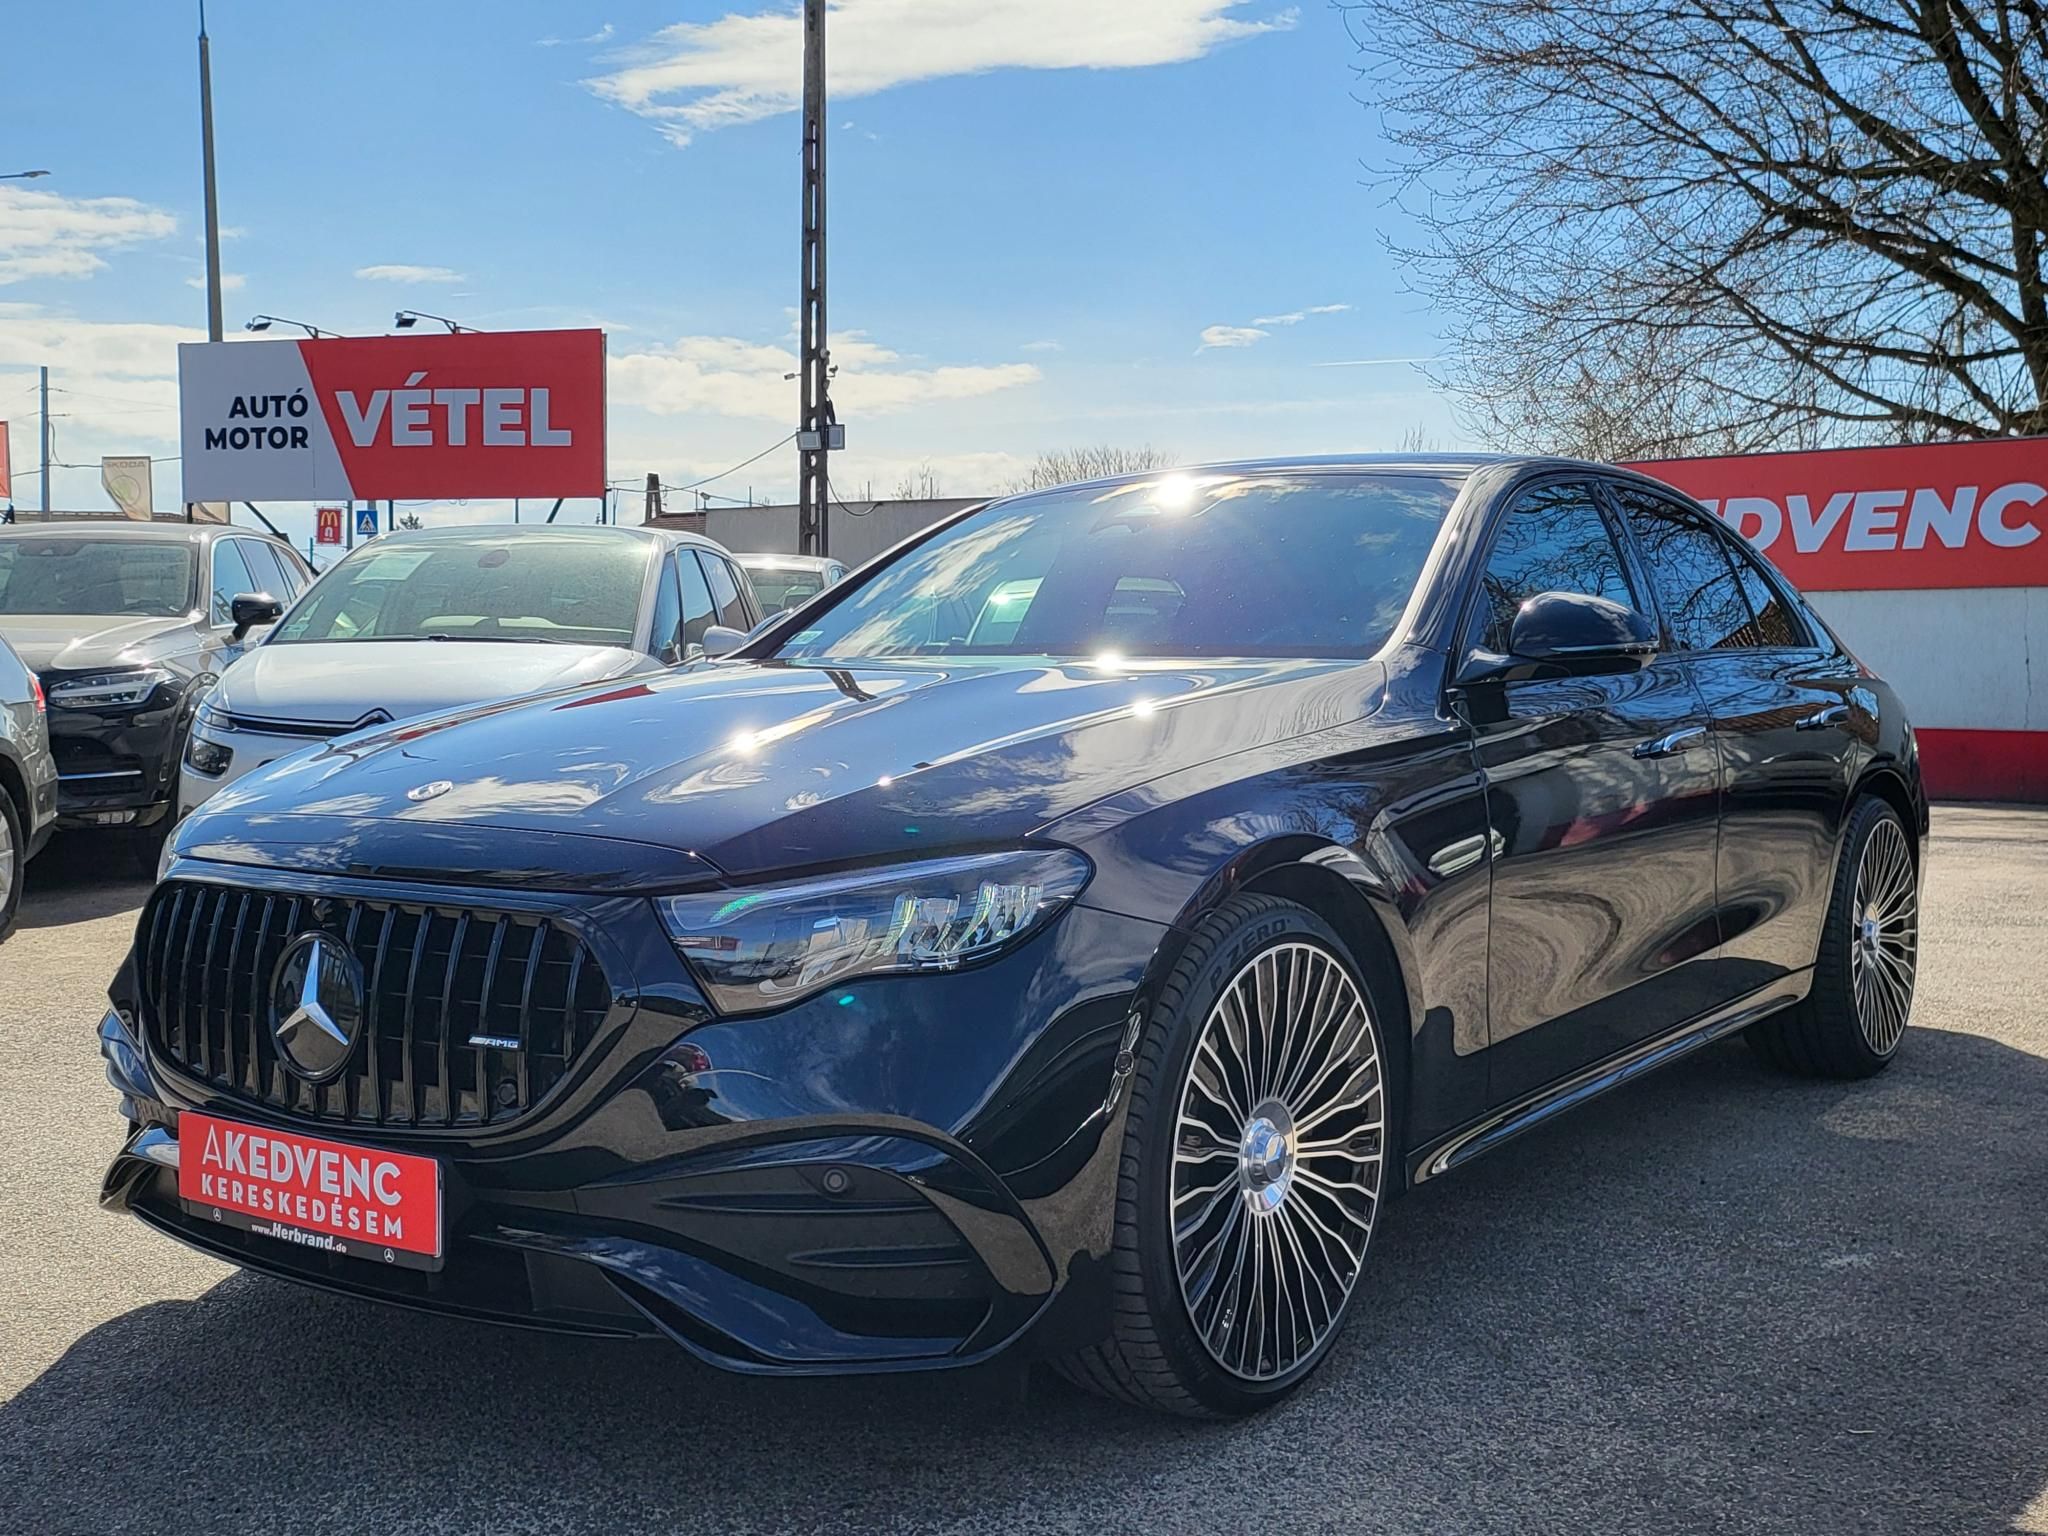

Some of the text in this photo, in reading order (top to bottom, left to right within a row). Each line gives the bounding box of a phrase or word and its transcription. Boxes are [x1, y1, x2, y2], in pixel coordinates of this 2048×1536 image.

[228, 387, 309, 419] AUTÓ
[335, 371, 573, 448] VÉTEL
[204, 425, 309, 450] MOTOR
[1700, 482, 2047, 554] DVENC
[484, 1038, 519, 1049] AMG
[201, 1172, 403, 1240] KERESKEDÉSEM
[251, 1222, 348, 1255] www.Herbrand.de
